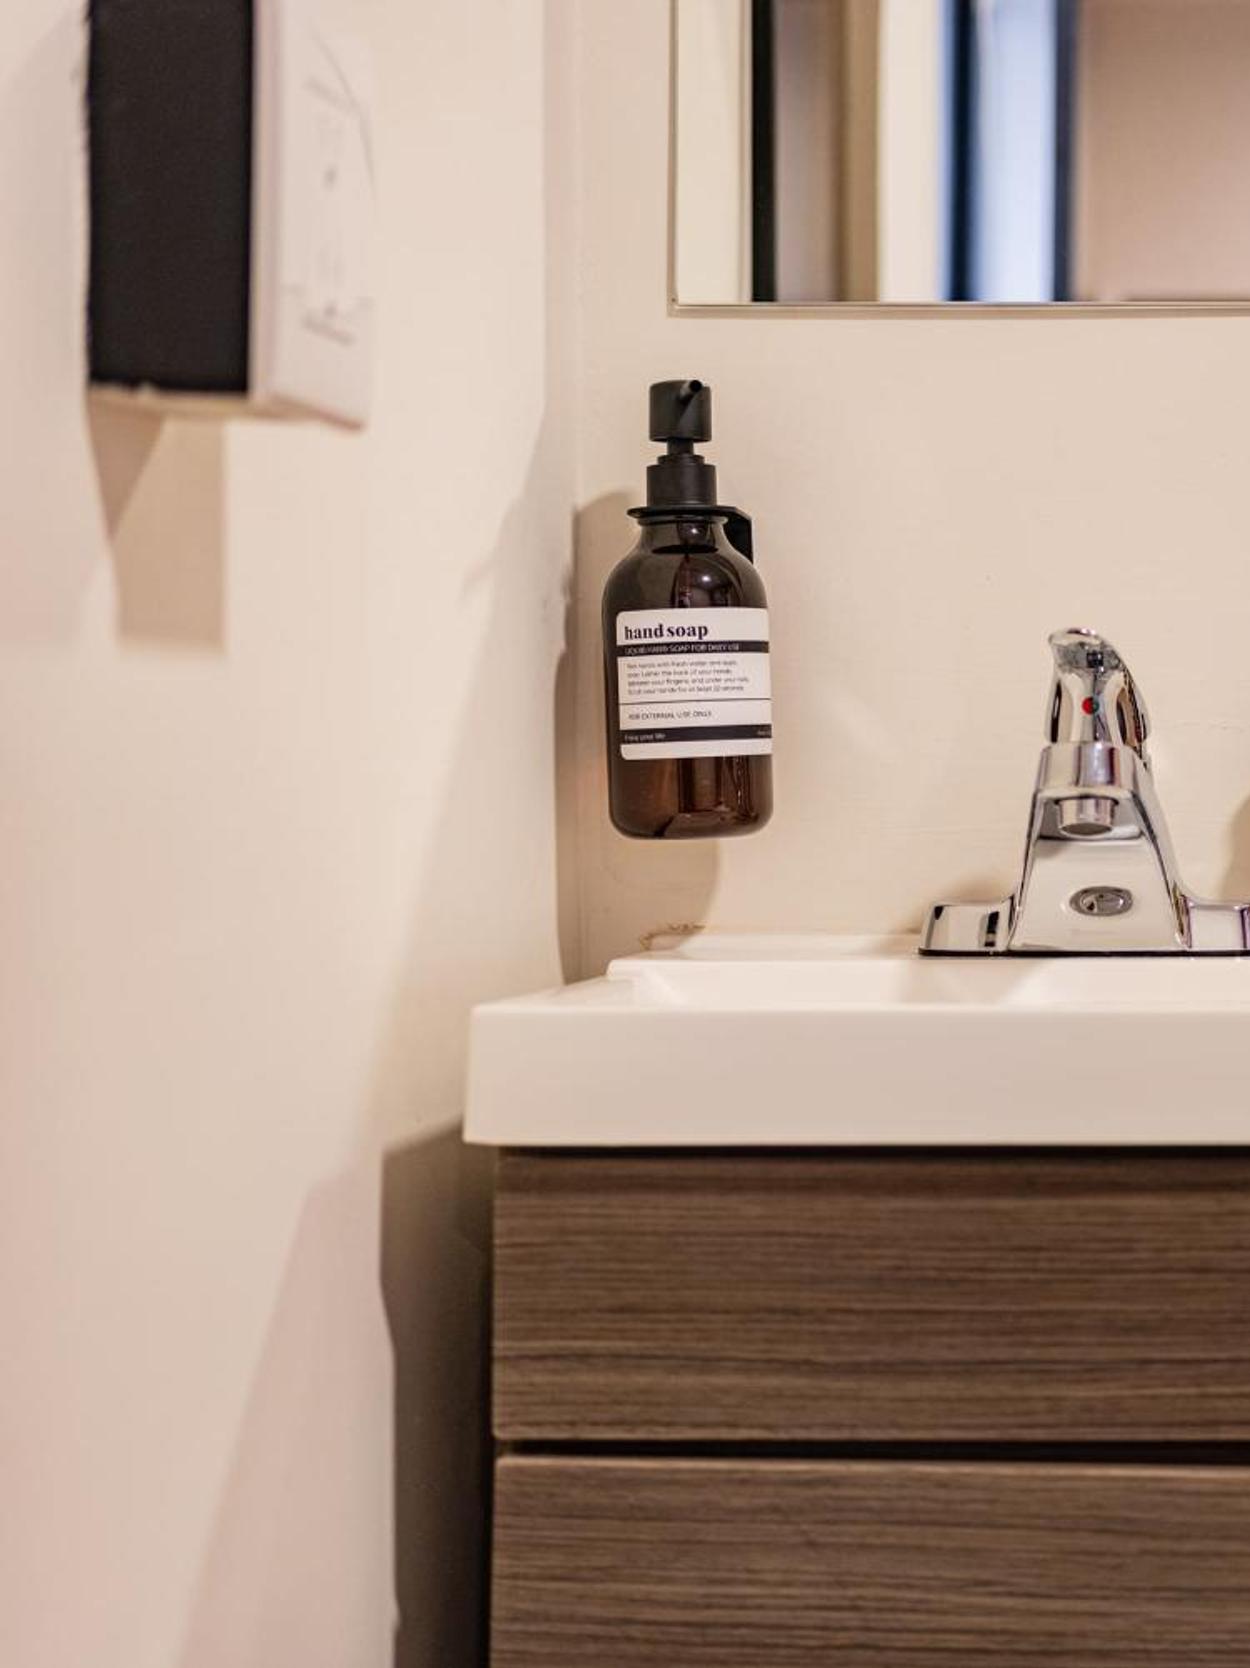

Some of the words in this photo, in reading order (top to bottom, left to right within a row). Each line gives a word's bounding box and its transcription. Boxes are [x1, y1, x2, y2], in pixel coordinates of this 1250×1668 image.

[624, 624, 664, 640] hand
[666, 625, 708, 640] soap
[669, 644, 691, 653] SOAP
[691, 644, 707, 652] FOR
[641, 712, 675, 720] EXTERNAL
[677, 711, 691, 719] USE
